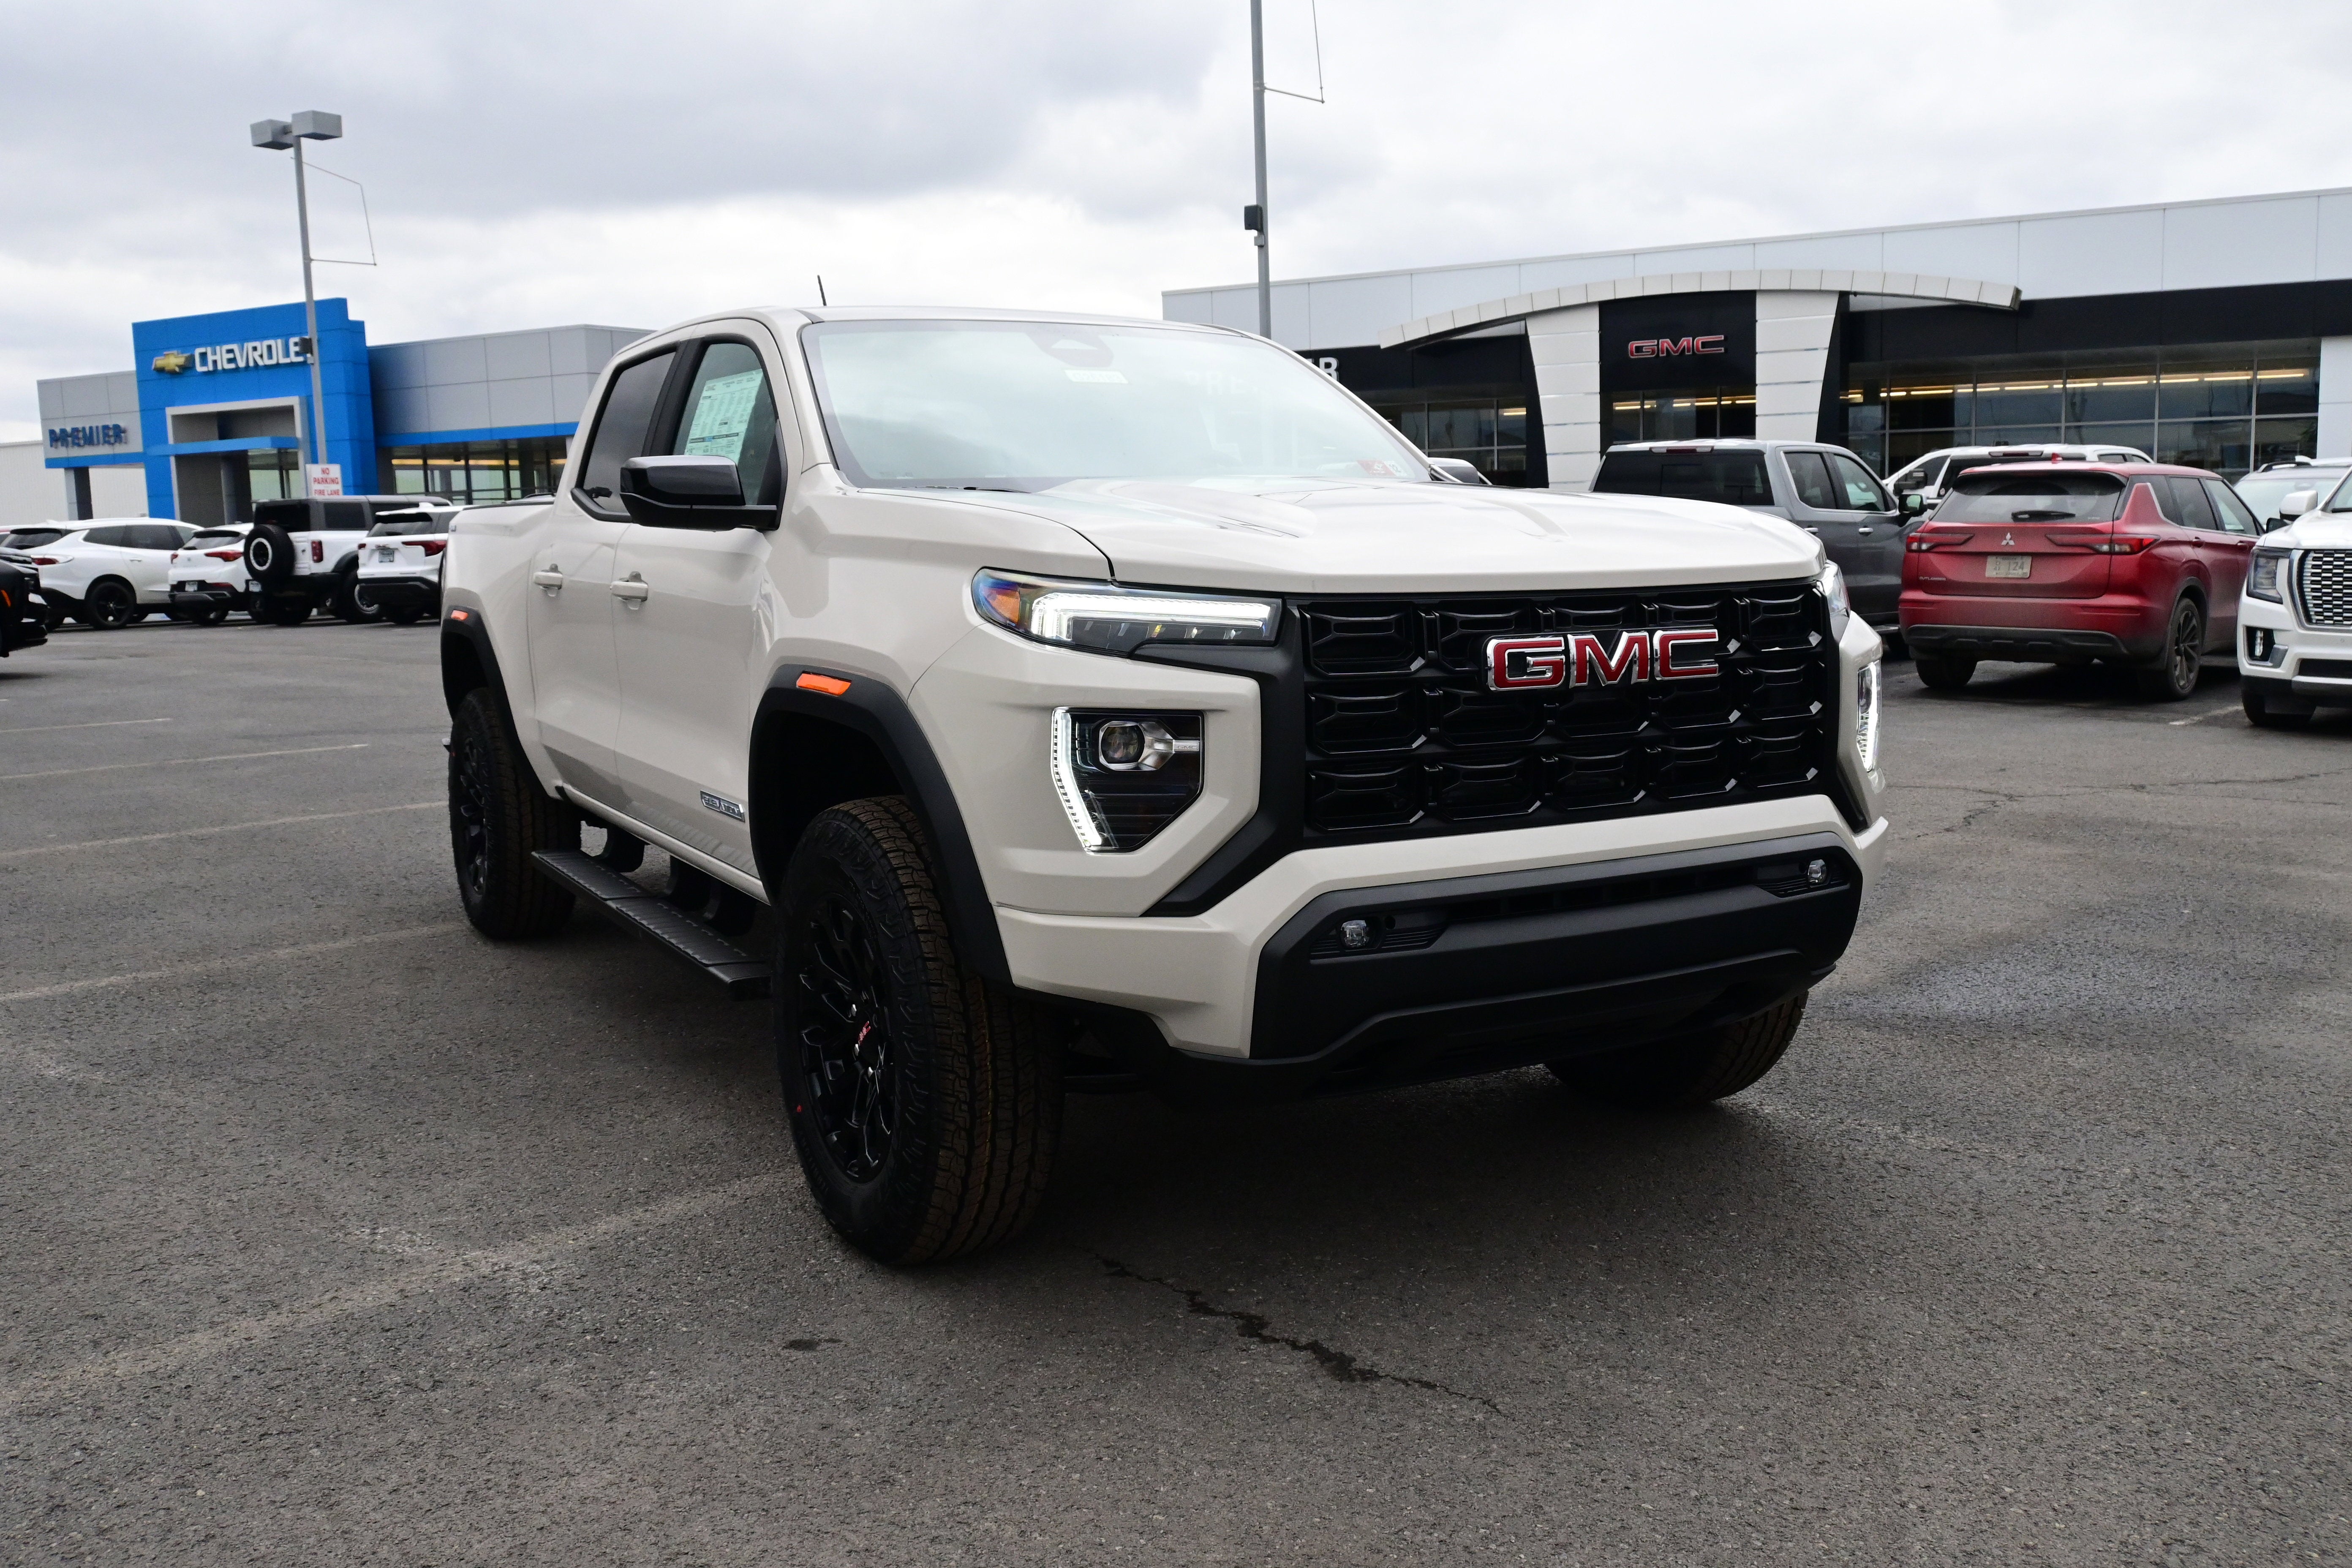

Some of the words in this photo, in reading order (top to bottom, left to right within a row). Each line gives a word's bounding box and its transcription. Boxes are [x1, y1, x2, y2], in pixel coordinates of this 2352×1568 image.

[194, 336, 313, 372] CHEVROLE
[1628, 335, 1724, 358] GMC
[48, 423, 124, 449] PREMIER
[1486, 629, 1719, 691] GMC
